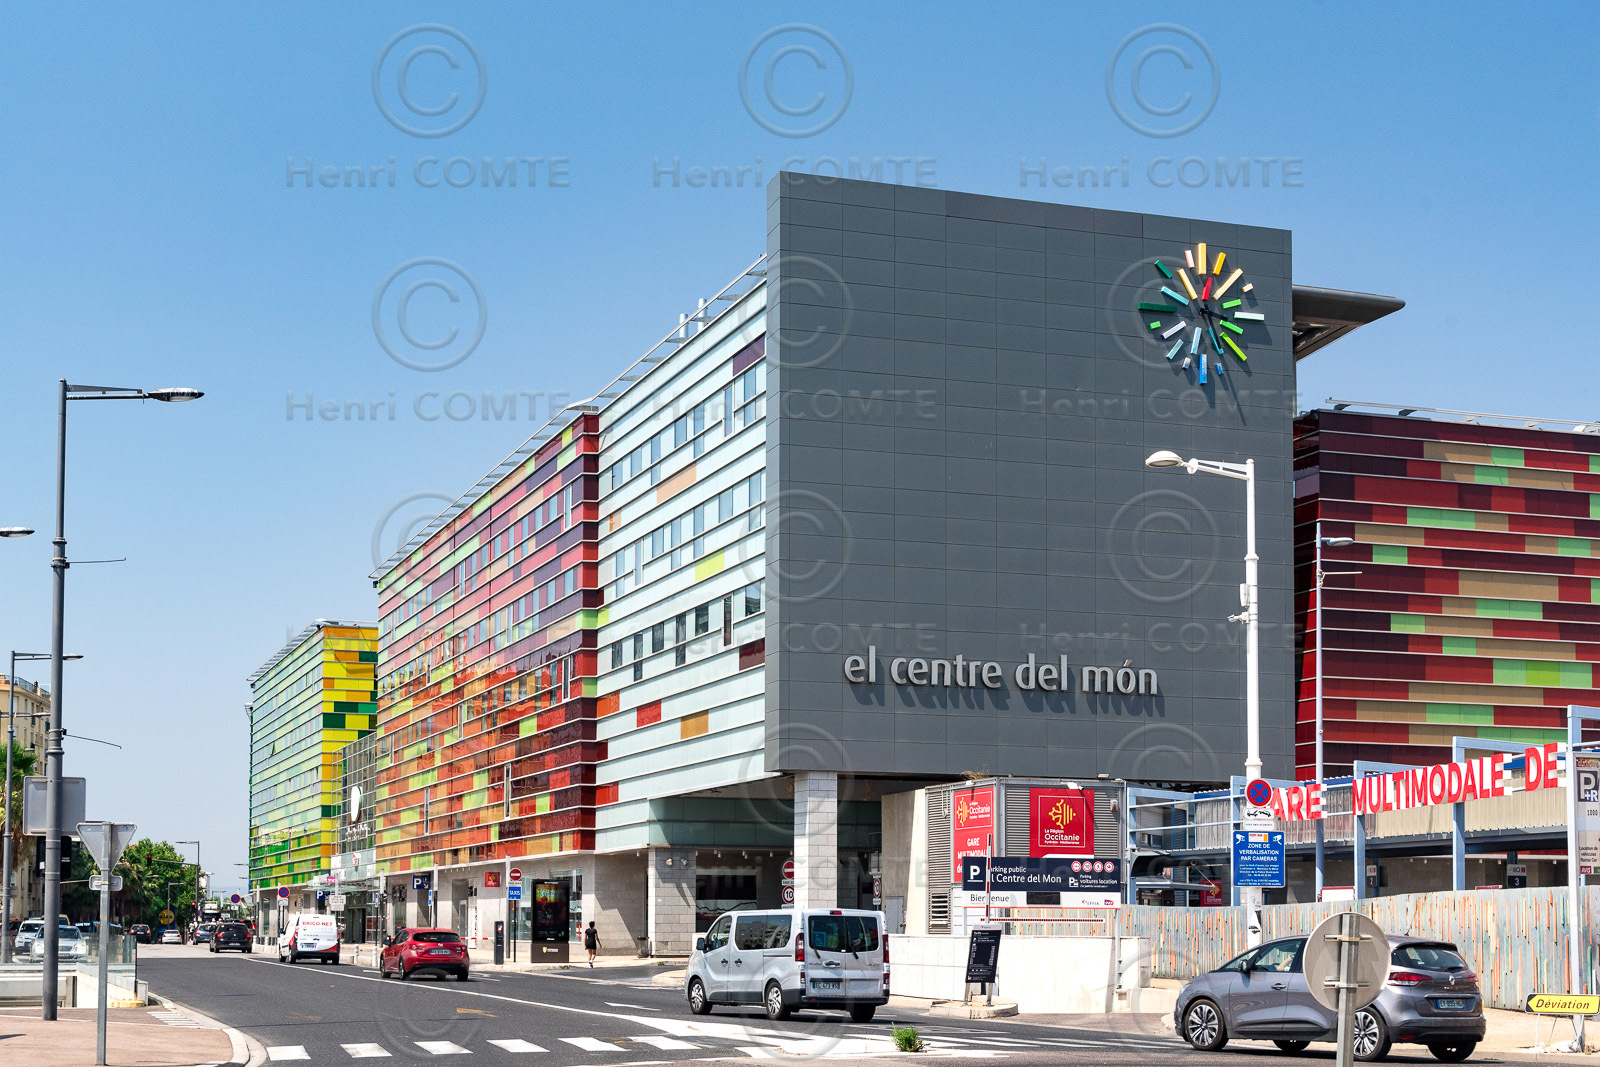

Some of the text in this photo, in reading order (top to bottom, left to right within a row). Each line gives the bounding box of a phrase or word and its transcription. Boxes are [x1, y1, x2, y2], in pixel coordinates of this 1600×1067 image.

[844, 645, 1158, 695] el centre del món
[1270, 742, 1558, 822] ARE MULTIMODALE DE
[970, 804, 990, 814] Occitanie
[967, 838, 980, 846] GARE
[958, 849, 987, 858] MULTIMODAL
[970, 866, 980, 880] P
[996, 874, 1025, 882] Centre
[1027, 874, 1040, 882] del
[1043, 874, 1062, 883] Mon
[1515, 878, 1519, 886] 3
[414, 878, 422, 889] P
[317, 891, 323, 899] P
[786, 890, 794, 899] 10
[1536, 999, 1590, 1009] Déviation
